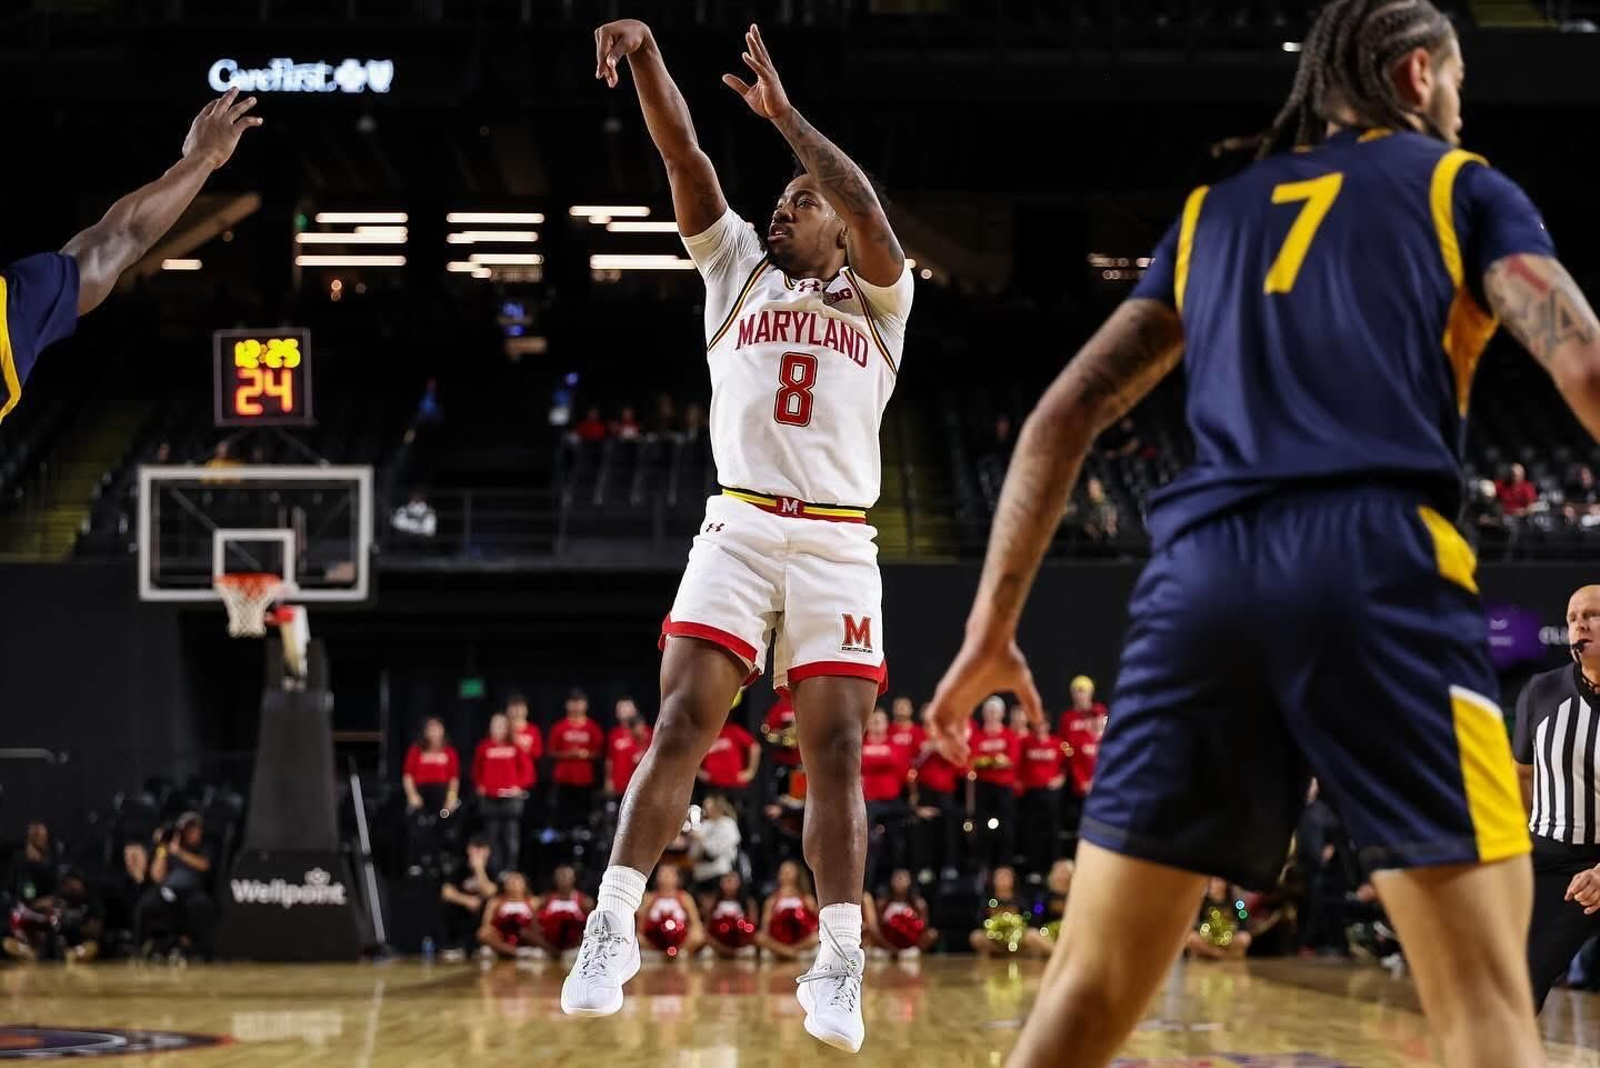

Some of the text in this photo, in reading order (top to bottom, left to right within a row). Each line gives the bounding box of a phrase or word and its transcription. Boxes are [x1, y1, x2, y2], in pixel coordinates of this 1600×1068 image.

[1263, 172, 1344, 295] 7
[735, 310, 868, 368] MARYLAND
[235, 368, 292, 415] 24
[774, 351, 818, 427] 8
[781, 497, 799, 515] M
[841, 612, 872, 649] M
[231, 878, 346, 909] Wellpoint
